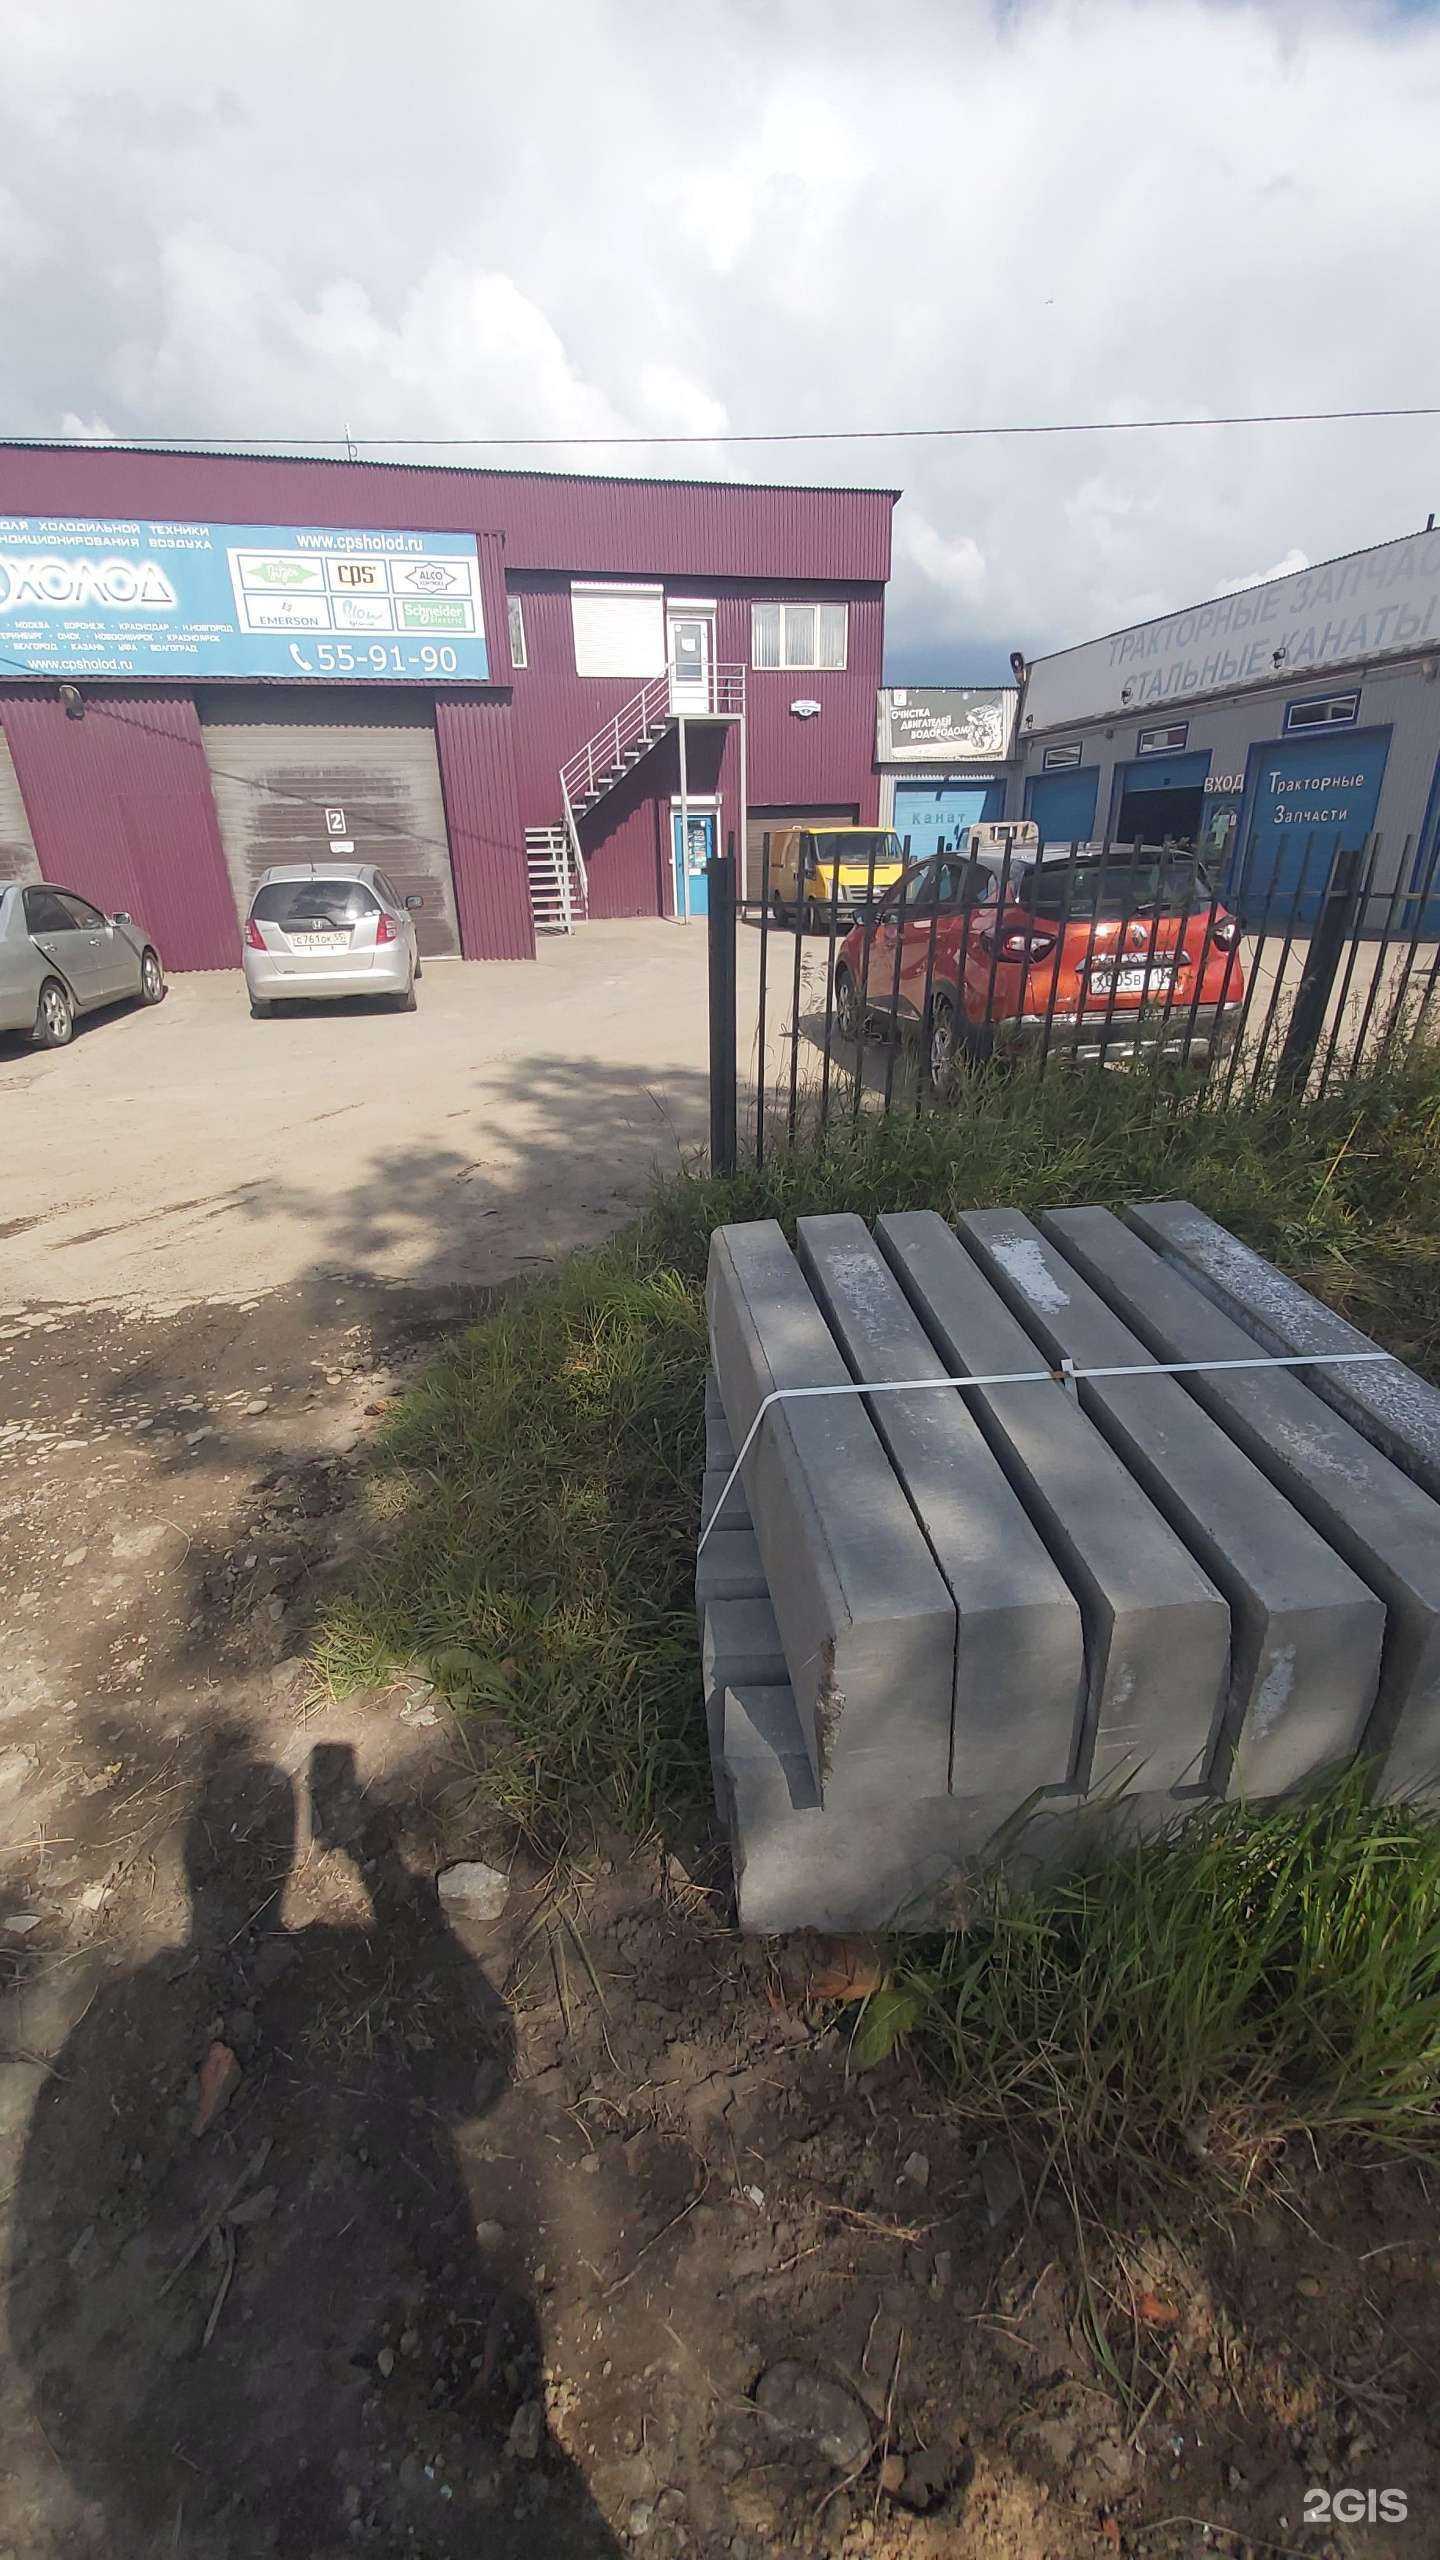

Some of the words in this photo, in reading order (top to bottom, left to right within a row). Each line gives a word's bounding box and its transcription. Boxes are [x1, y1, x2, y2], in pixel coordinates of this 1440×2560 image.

[38, 520, 141, 534] ХОЛОДИЛЬНОЙ
[149, 524, 210, 536] ТЕХНИКИ
[148, 538, 213, 549] ВОЗДУХА
[296, 534, 424, 552] www.cpsholod.ru
[260, 616, 320, 626] EMERSON
[404, 603, 463, 624] Schneider
[1109, 587, 1285, 666] ТРАКТОРНЫЕ
[1122, 638, 1271, 701] СТАЛЬНЫЕ
[1280, 594, 1438, 667] КАНАТЫ
[27, 657, 133, 672] www.cpsholod.ru
[317, 644, 458, 672] 55-91-90
[891, 708, 931, 720] ОЧИСТКА
[900, 715, 952, 731] ДВИГАТЕЛЕЙ
[1204, 773, 1245, 794] ВХОД
[1269, 771, 1365, 795] Тракторные
[331, 814, 342, 829] 2
[912, 812, 966, 825] Канат
[1273, 804, 1348, 824] Запчасти
